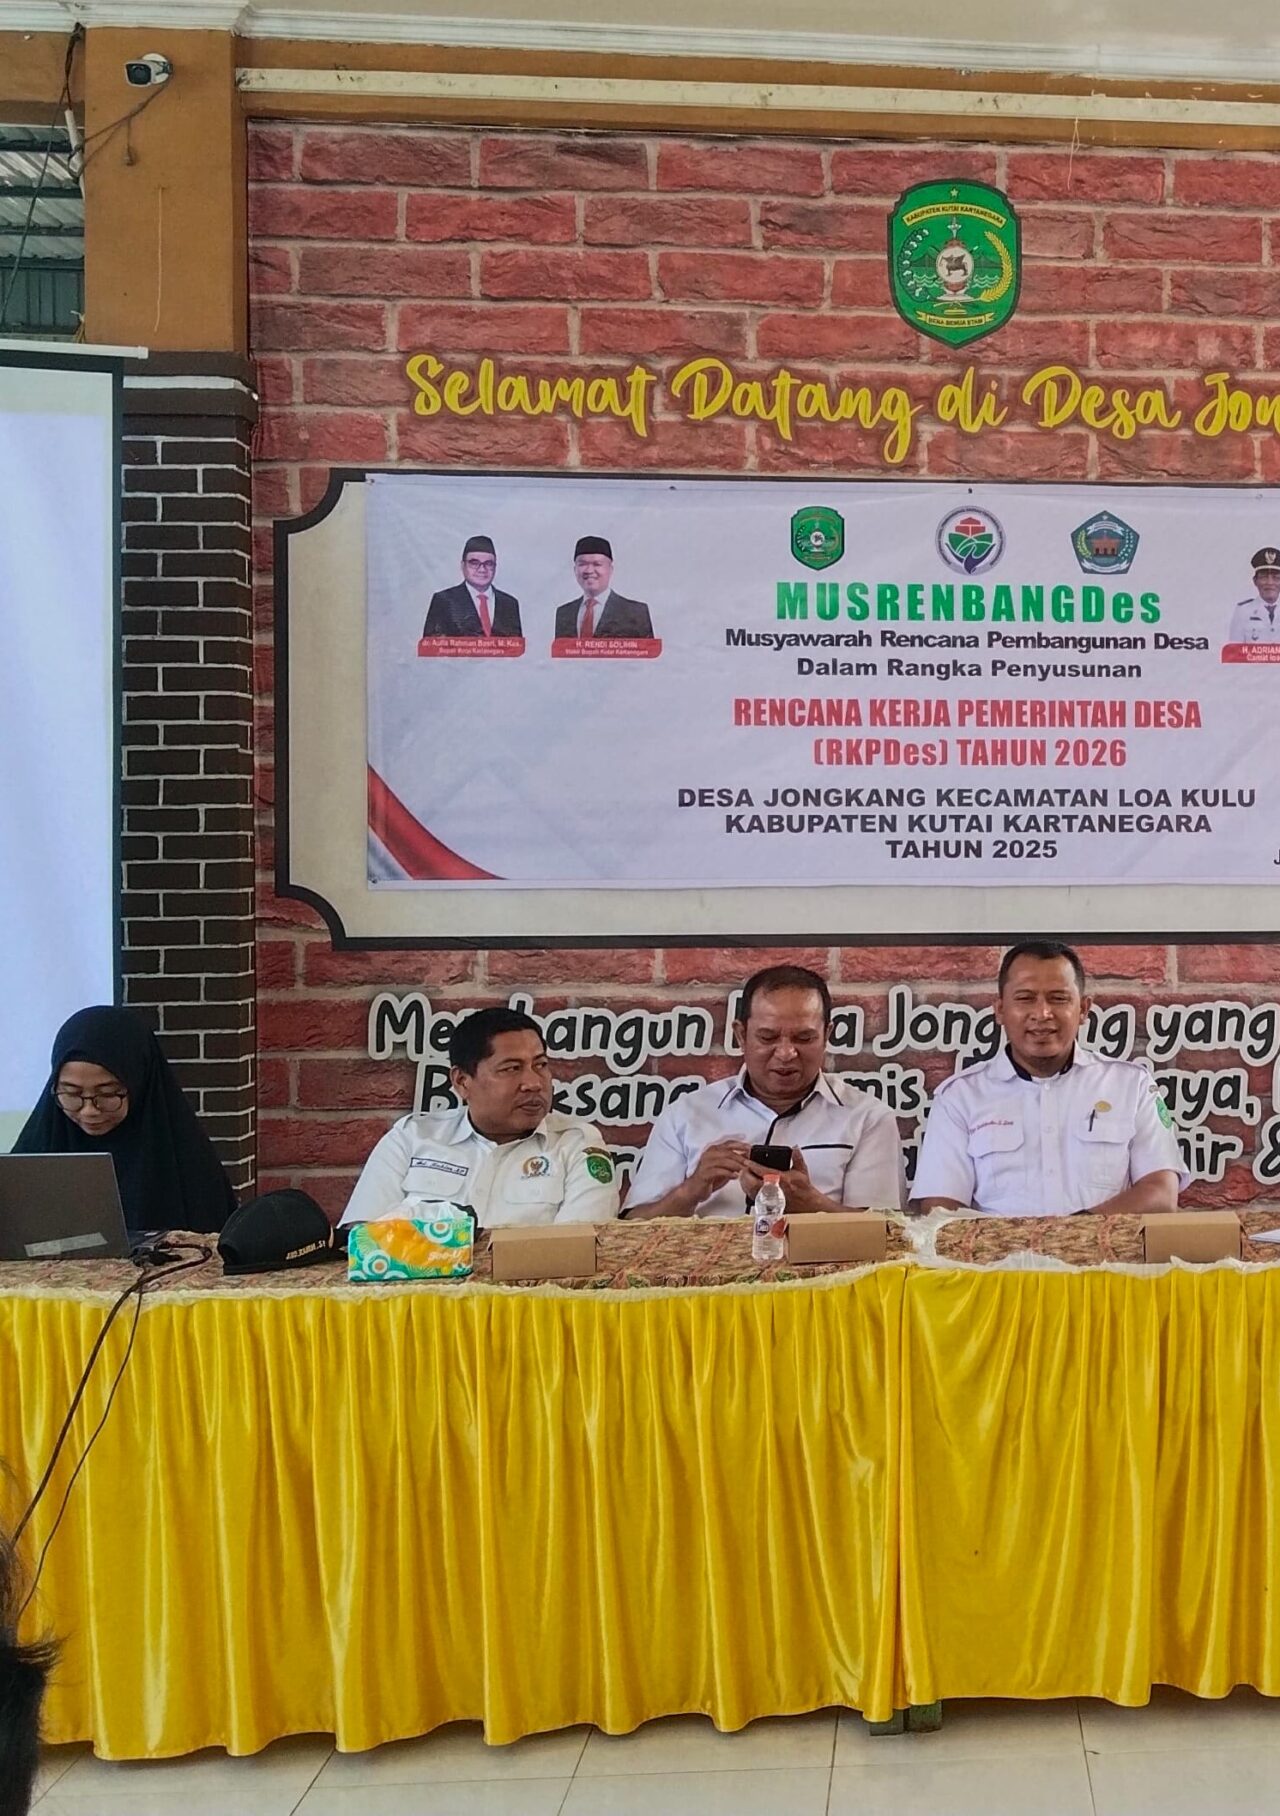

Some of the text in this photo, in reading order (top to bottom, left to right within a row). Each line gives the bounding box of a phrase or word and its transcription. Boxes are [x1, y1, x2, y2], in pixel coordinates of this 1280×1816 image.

[406, 352, 656, 439] Selamat
[671, 356, 923, 464] Datang
[937, 366, 1008, 433] di
[1023, 366, 1181, 440] Desa
[776, 582, 1161, 624] MUSRENBANGDes
[725, 628, 1209, 654] Musyawarah Rencana Pembangunan Desa
[797, 657, 1142, 682] Dalam Rangka Penyusunan
[734, 698, 1201, 728] RENCANA KERJA PEMERINTAH DESA
[814, 739, 1126, 766] (RKPDes) TAHUN 2026
[678, 788, 1255, 808] DESA JONGKANG KECAMATAN LOA KULU
[725, 814, 1212, 834] KABUPATEN KUTAI KARTANEGARA
[885, 839, 1058, 859] TAHUN 2025
[375, 998, 707, 1068] Meangun
[1152, 1006, 1276, 1060] yang
